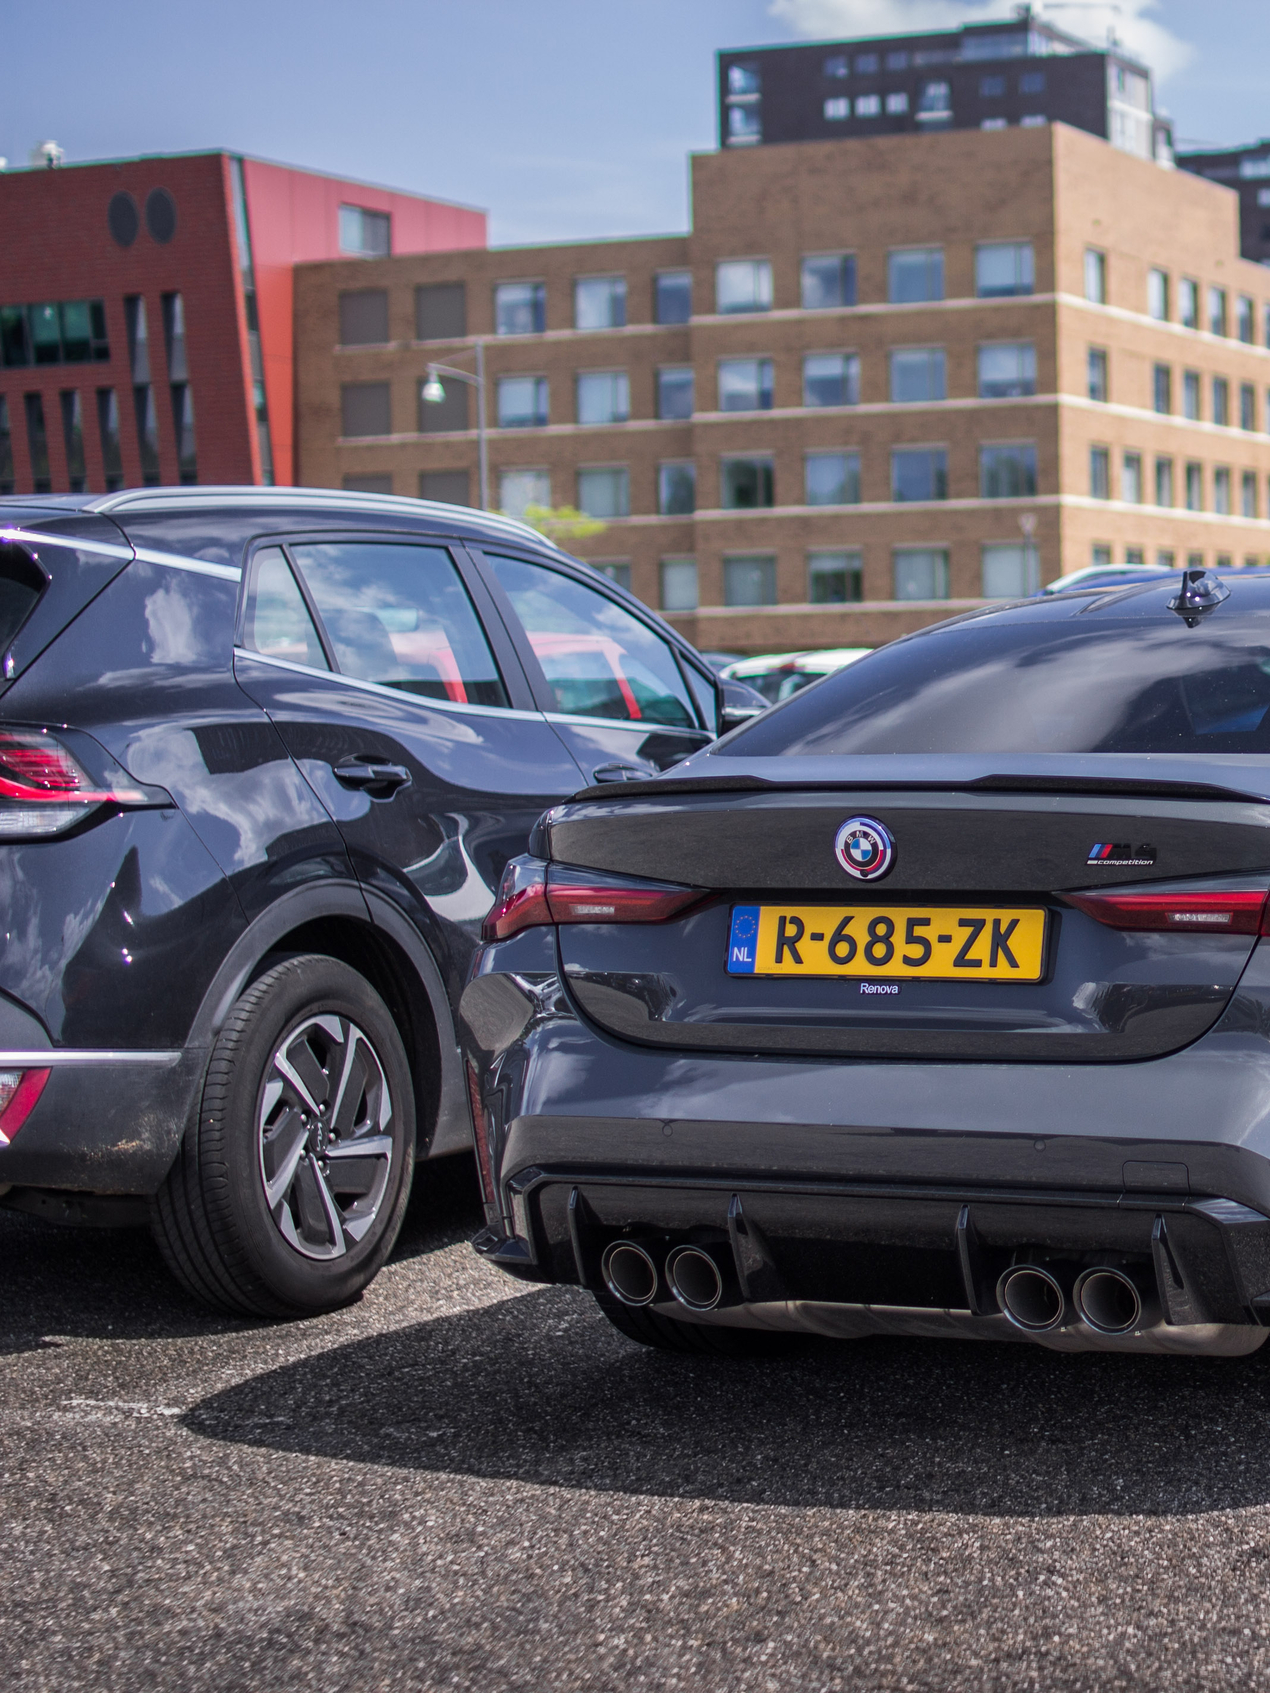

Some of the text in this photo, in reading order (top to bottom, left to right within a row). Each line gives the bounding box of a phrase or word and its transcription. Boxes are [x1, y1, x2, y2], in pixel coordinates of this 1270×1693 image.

[845, 830, 876, 844] BMW
[774, 915, 1021, 969] R-685-ZK
[732, 946, 752, 962] NL
[860, 982, 899, 994] Renova
